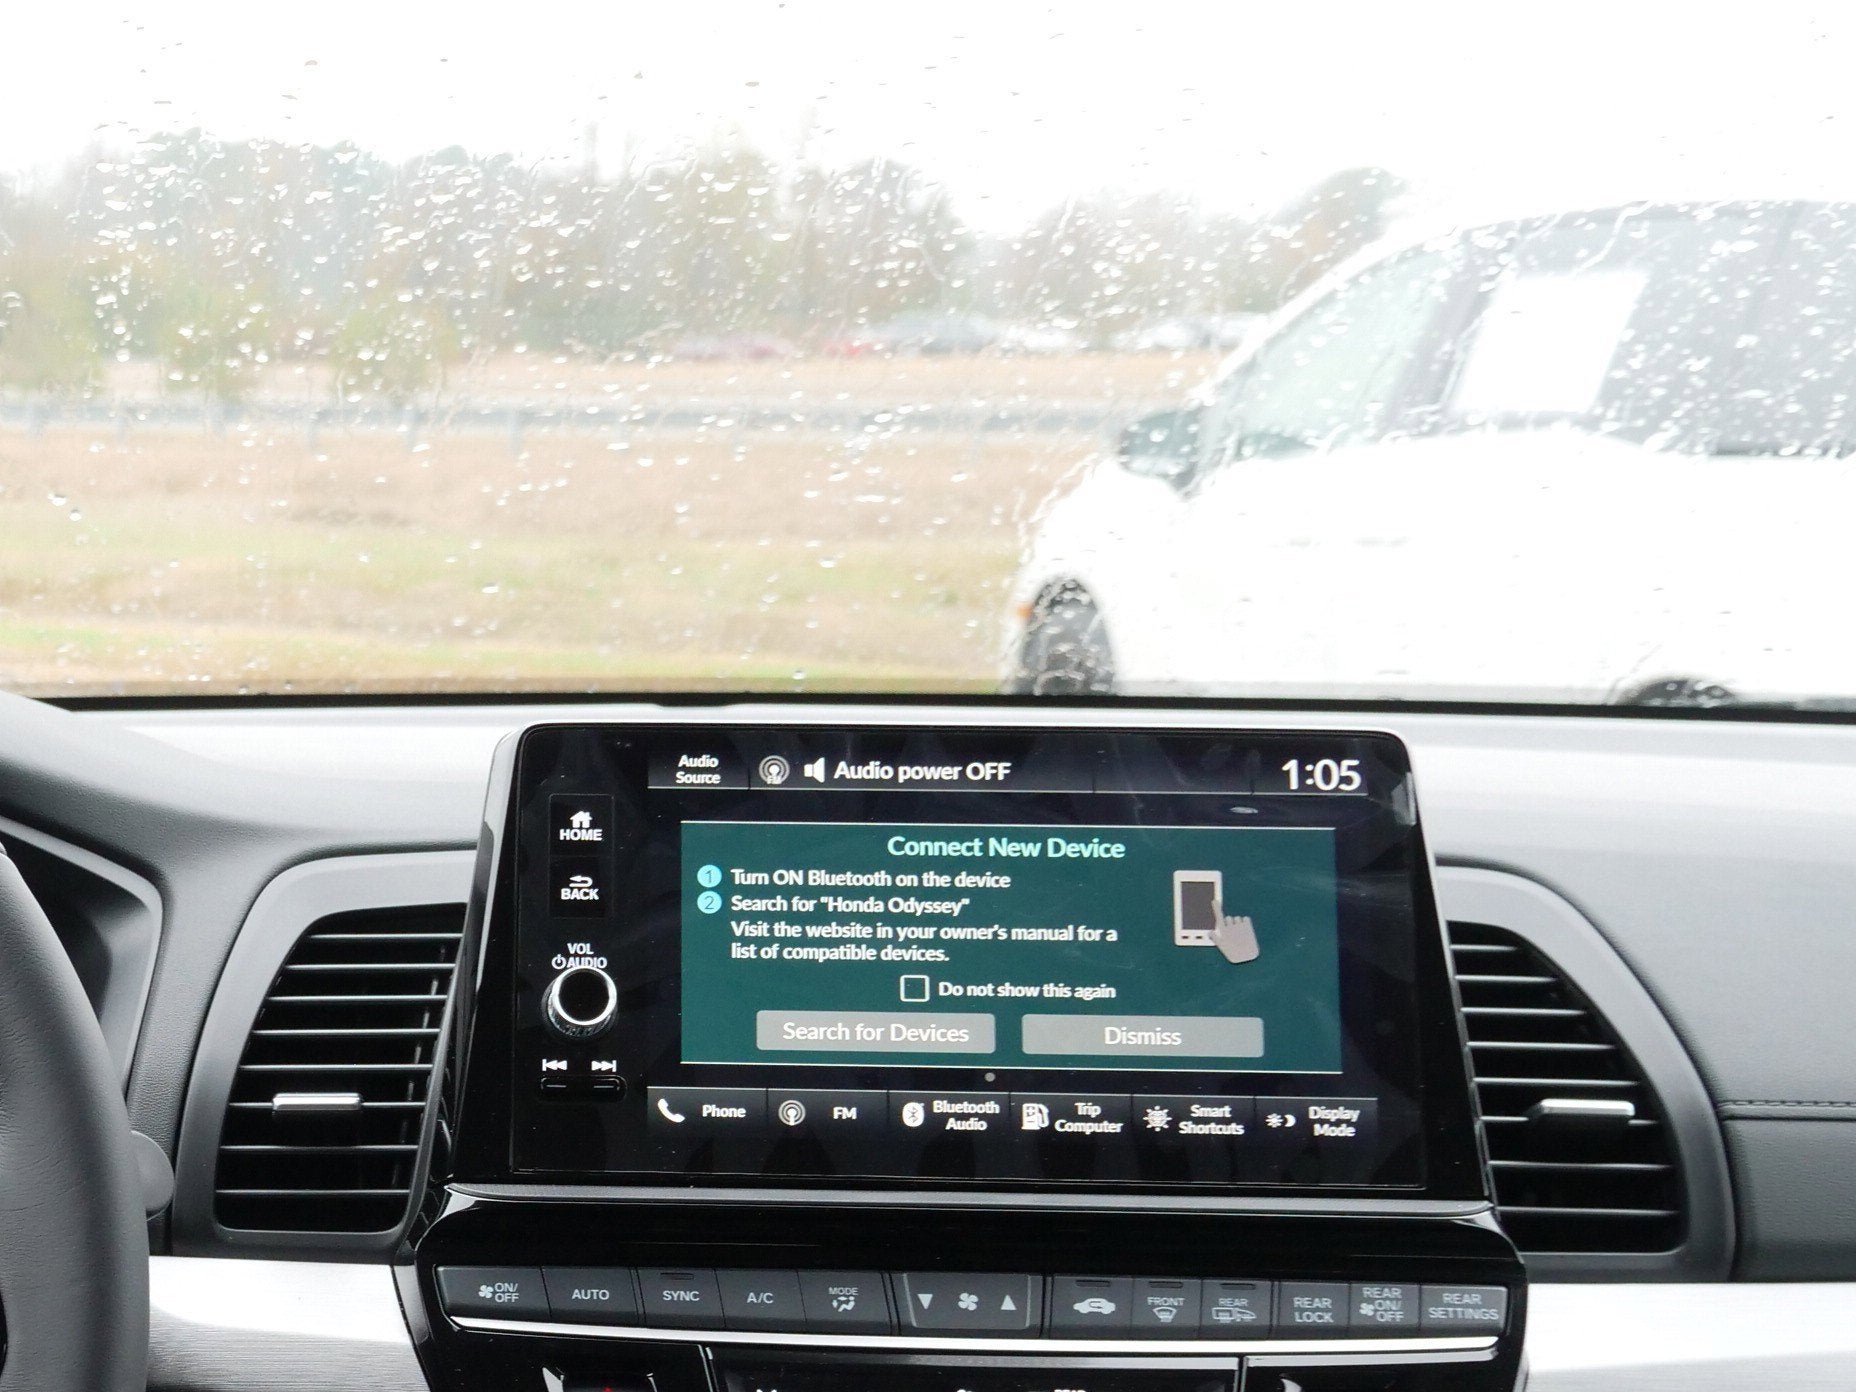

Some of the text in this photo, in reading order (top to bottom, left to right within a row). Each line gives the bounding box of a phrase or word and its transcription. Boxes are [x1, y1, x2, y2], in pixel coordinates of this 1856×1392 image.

[678, 755, 719, 768] Audio
[675, 771, 721, 784] Source
[834, 762, 1011, 784] Audio power OFF
[1282, 759, 1362, 791] 1:05
[559, 828, 603, 842] HOME
[887, 836, 1125, 859] Connect New Device
[730, 869, 769, 885] Turn
[773, 870, 804, 886] ON
[808, 870, 892, 887] Bluetooth
[895, 874, 918, 887] on
[921, 871, 951, 887] the
[954, 871, 1011, 888] device
[560, 887, 599, 900] BACK
[731, 895, 787, 911] Search
[791, 896, 817, 912] for
[730, 921, 1118, 942] Visit the website in your owner's manual for a
[567, 943, 594, 955] VOL
[731, 943, 950, 963] list of compatible devices.
[566, 956, 608, 969] AUDIO
[938, 982, 1117, 1001] Do not show this again
[782, 1022, 970, 1042] Search for Devices
[1104, 1027, 1182, 1046] Dismiss
[702, 1104, 746, 1118] Phone
[833, 1106, 857, 1119] FM
[933, 1100, 1000, 1114] Bluetooth
[1074, 1102, 1101, 1118] Trip
[1190, 1104, 1232, 1118] Smart
[1308, 1106, 1361, 1122] Display
[945, 1117, 987, 1131] Audio
[1055, 1119, 1123, 1135] Computer
[1179, 1121, 1244, 1135] Shortcuts
[1313, 1122, 1356, 1137] Mode
[494, 1282, 519, 1293] ON/
[828, 1287, 858, 1296] MODE
[1363, 1287, 1402, 1299] REAR
[495, 1292, 519, 1303] OFF
[572, 1289, 610, 1301] AUTO
[662, 1289, 700, 1302] SYNC
[747, 1291, 774, 1305] A/C
[1147, 1297, 1185, 1307] FRONT
[1442, 1293, 1481, 1306] REAR
[1218, 1298, 1249, 1308] REAR
[1294, 1297, 1332, 1309] REAR
[1375, 1300, 1401, 1311] ON/
[1295, 1311, 1333, 1323] LOCK
[1376, 1310, 1404, 1322] OFF
[1428, 1307, 1499, 1321] SETTINGS
